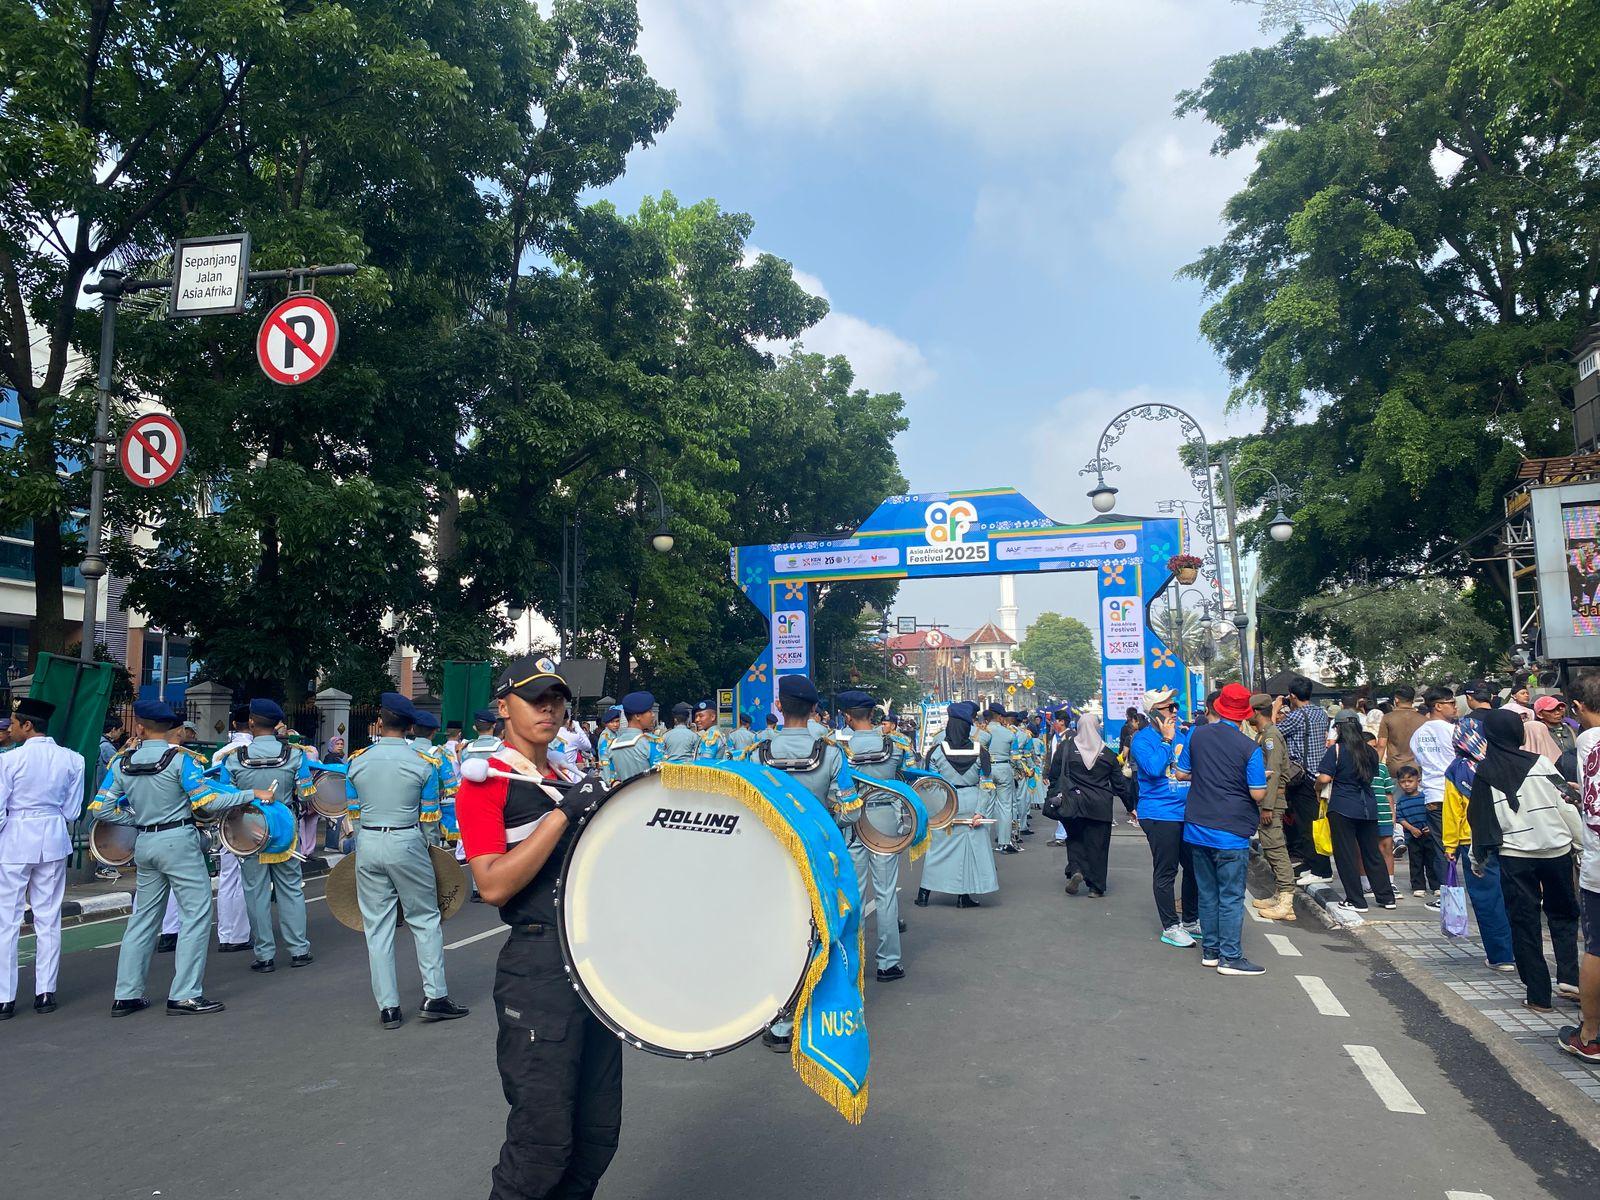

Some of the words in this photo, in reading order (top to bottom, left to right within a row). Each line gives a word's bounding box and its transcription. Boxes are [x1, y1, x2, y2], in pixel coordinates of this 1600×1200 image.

[184, 254, 237, 269] Sepanjang
[196, 271, 223, 283] Jalan
[182, 287, 203, 299] Asia
[204, 285, 233, 298] Afrika
[909, 555, 944, 563] Festival
[945, 545, 987, 561] 2025
[646, 807, 740, 835] ROLLING
[821, 1009, 863, 1037] NUS
